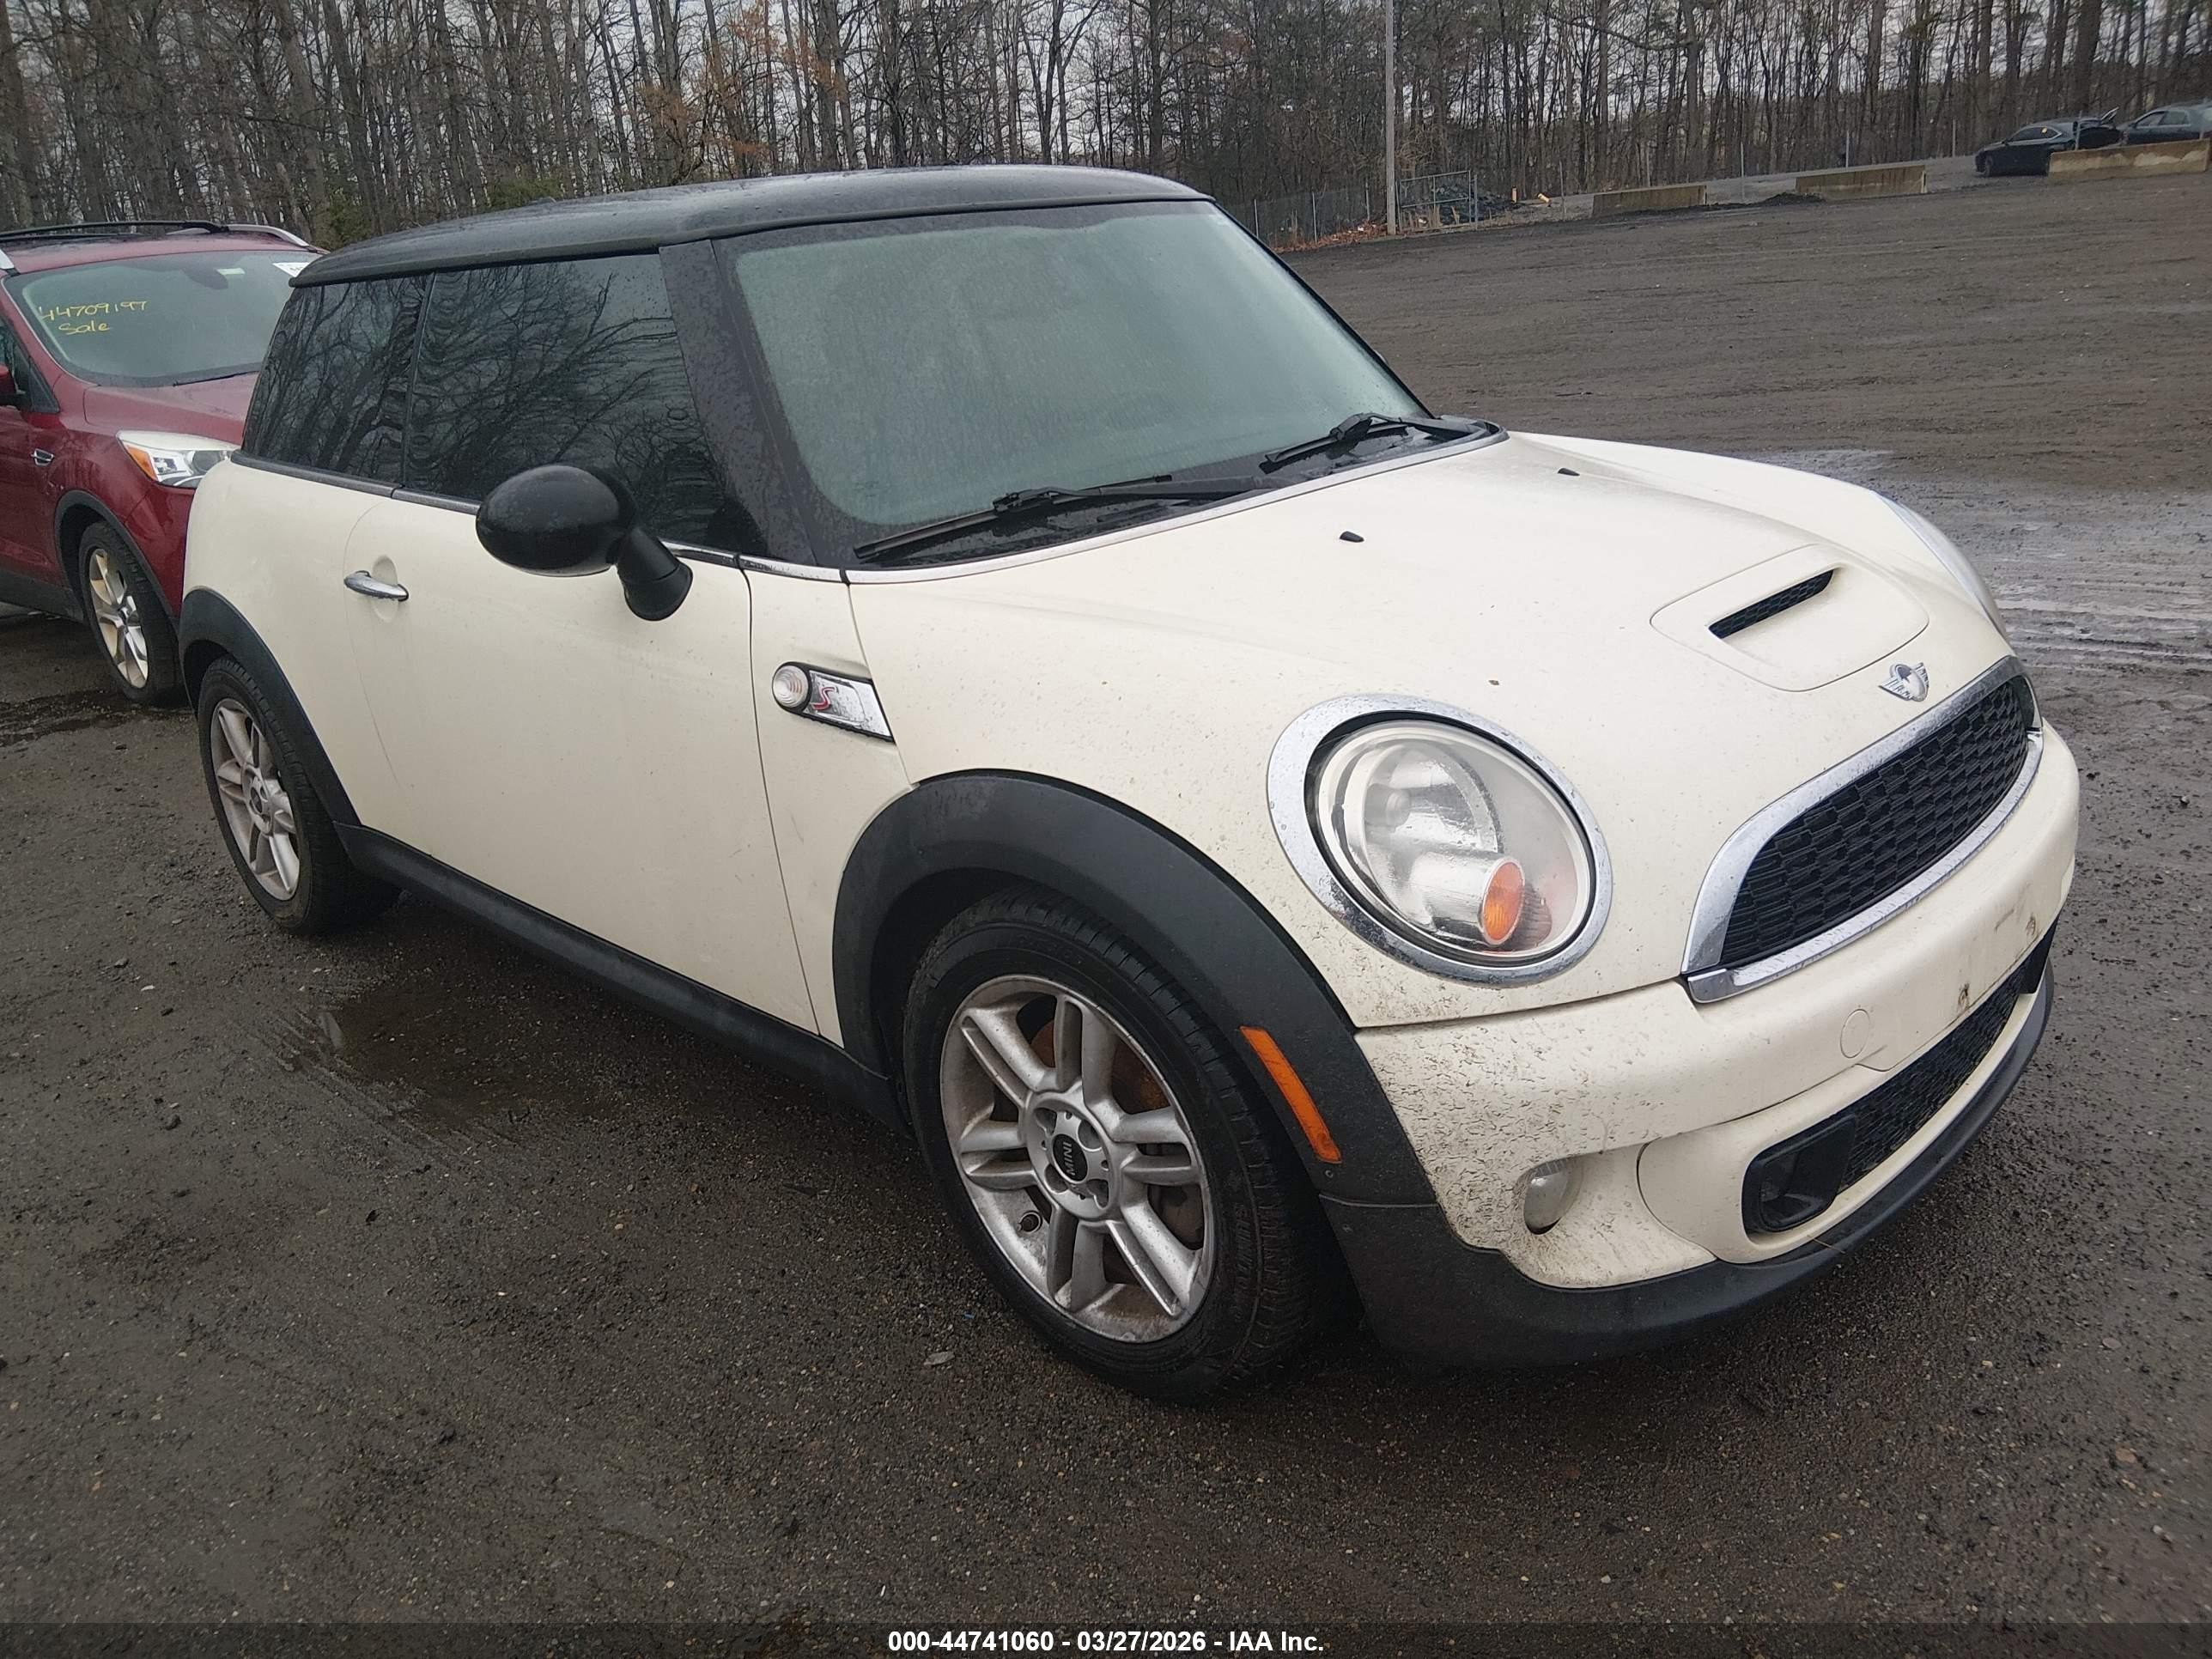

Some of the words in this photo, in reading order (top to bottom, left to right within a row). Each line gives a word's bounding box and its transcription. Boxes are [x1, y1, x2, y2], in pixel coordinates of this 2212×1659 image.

[38, 301, 148, 321] 44709197
[58, 319, 111, 336] Sale
[1062, 1141, 1076, 1176] MINI
